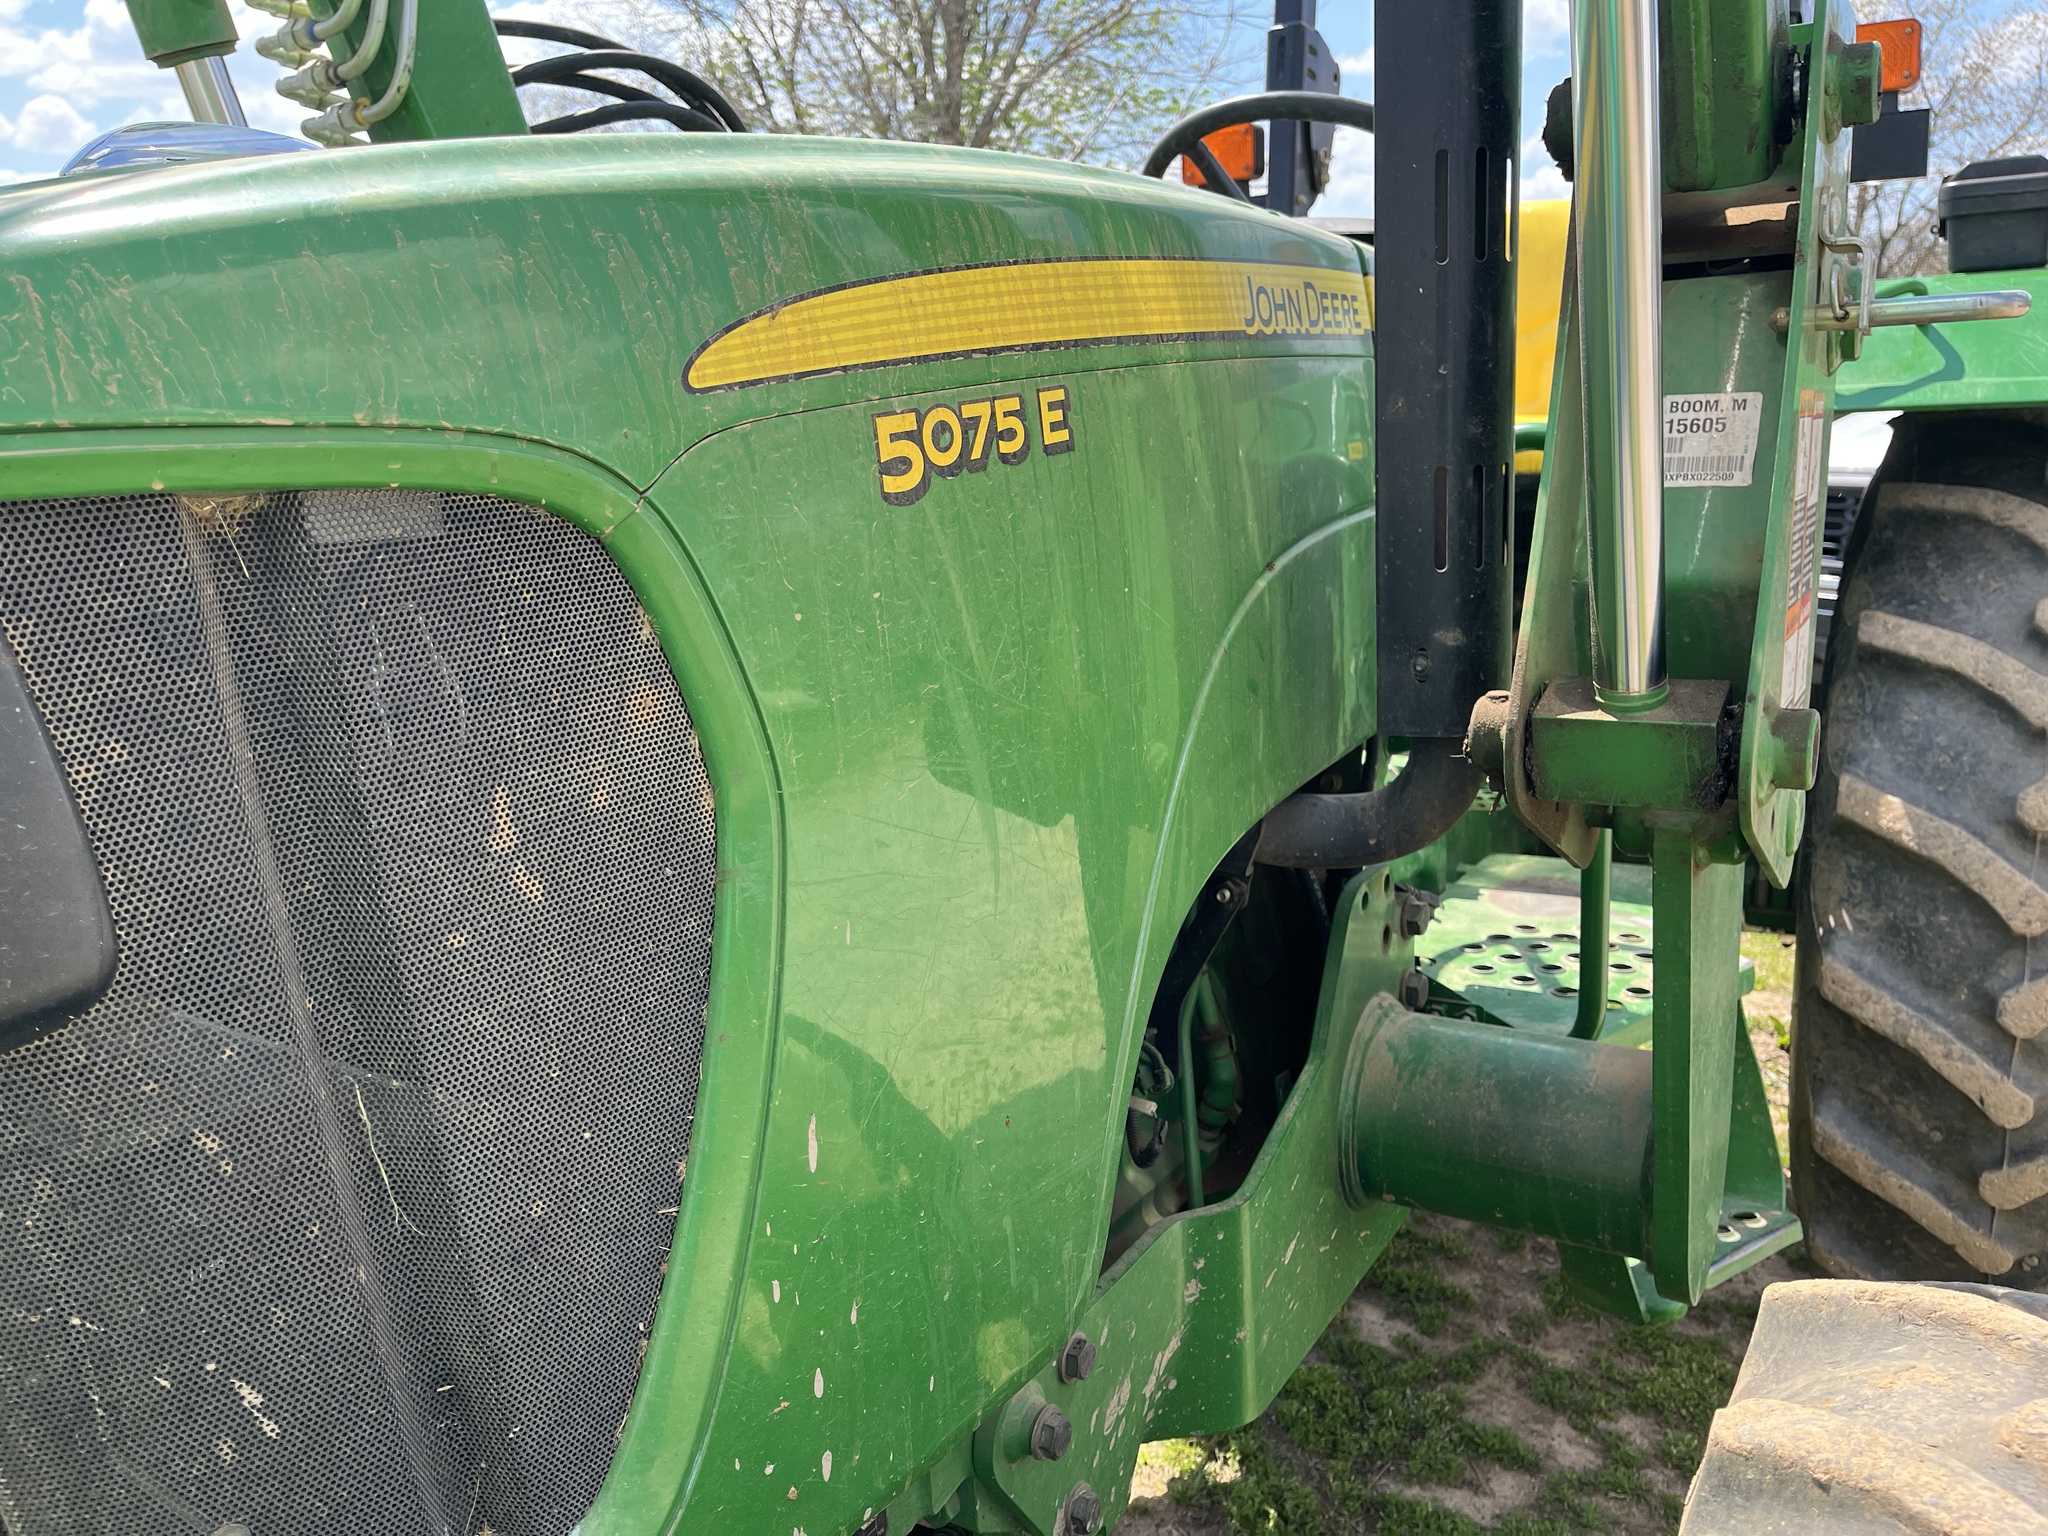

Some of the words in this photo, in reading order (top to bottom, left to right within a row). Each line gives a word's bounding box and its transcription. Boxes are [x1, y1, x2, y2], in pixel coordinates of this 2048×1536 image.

[1244, 275, 1303, 329] JOHN
[1303, 281, 1362, 330] DEERE
[1669, 400, 1724, 413] BOOM,
[1732, 398, 1747, 411] M
[1665, 417, 1727, 434] 15605
[872, 394, 1029, 503] 5075
[1037, 387, 1073, 452] E
